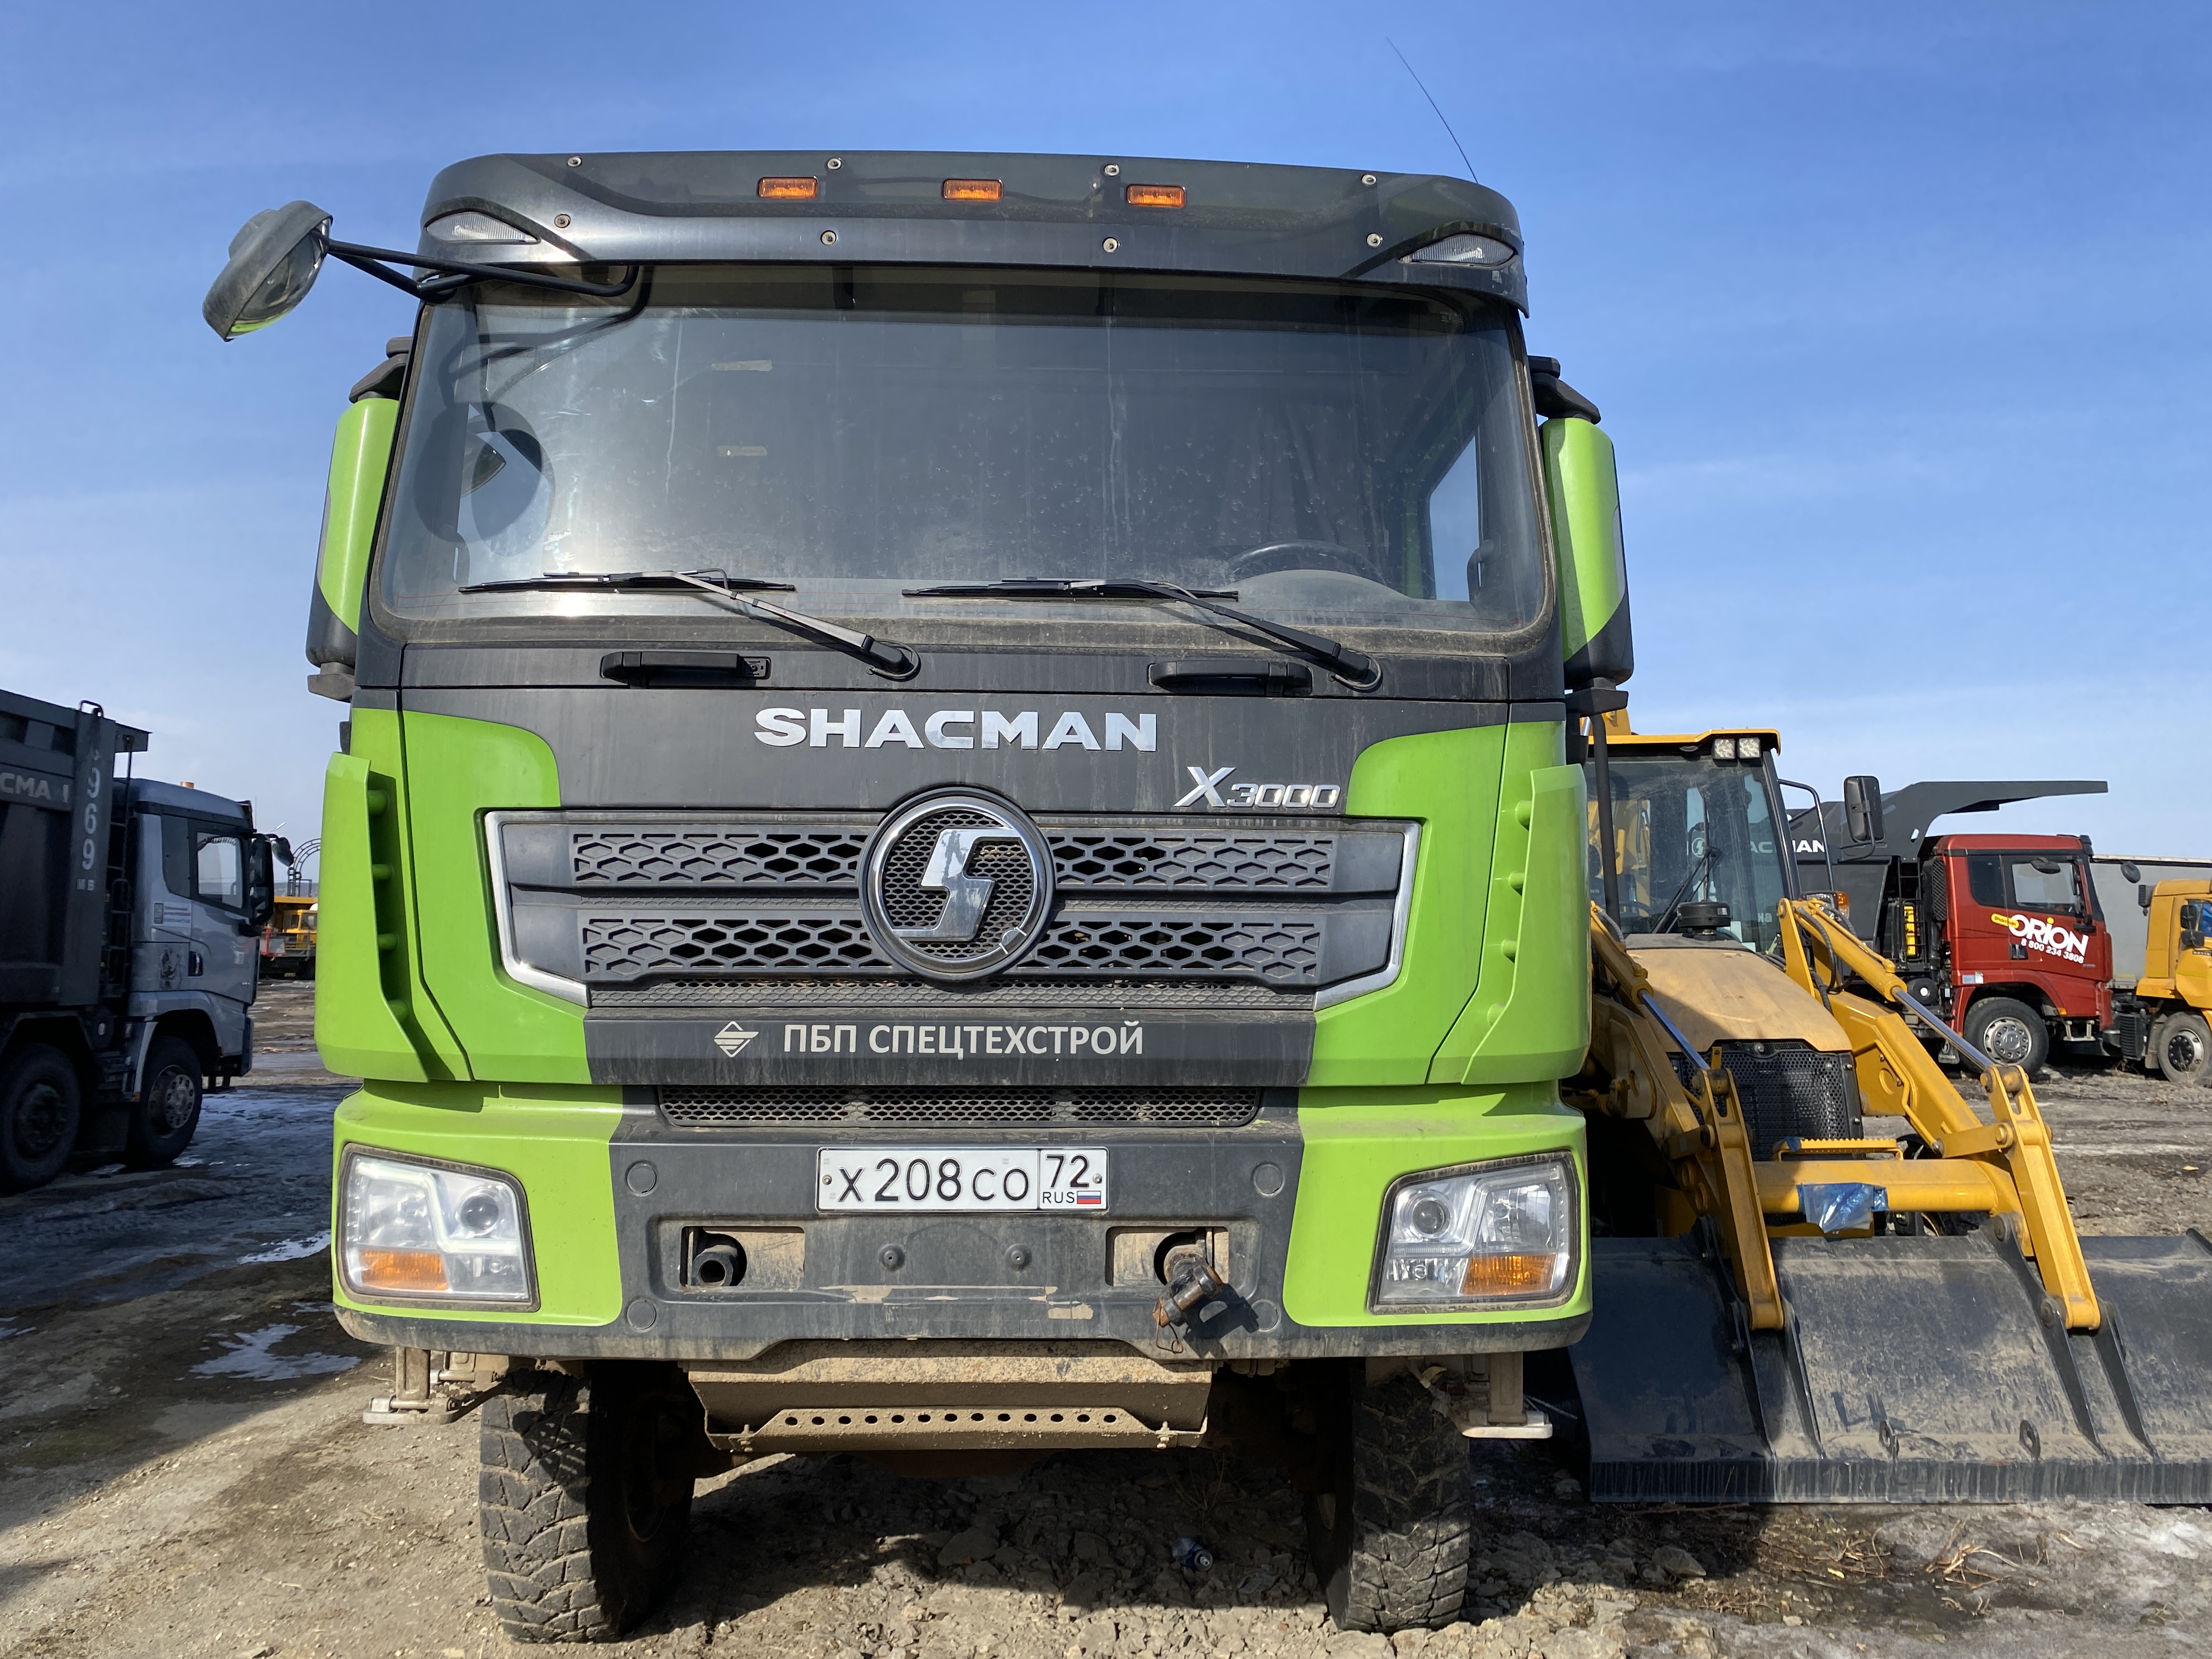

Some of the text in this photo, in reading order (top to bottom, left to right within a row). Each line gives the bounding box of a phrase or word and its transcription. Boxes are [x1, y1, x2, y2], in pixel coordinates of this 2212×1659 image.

[754, 707, 1158, 752] SHACMAN
[1173, 766, 1341, 808] X3000
[82, 749, 100, 871] 969
[2021, 938, 2085, 964] 8 800 234 3808
[783, 1020, 1143, 1060] ПБП СПЕЦТЕХСТРОЙ
[1045, 1153, 1090, 1188] 72
[1042, 1191, 1075, 1204] RUS
